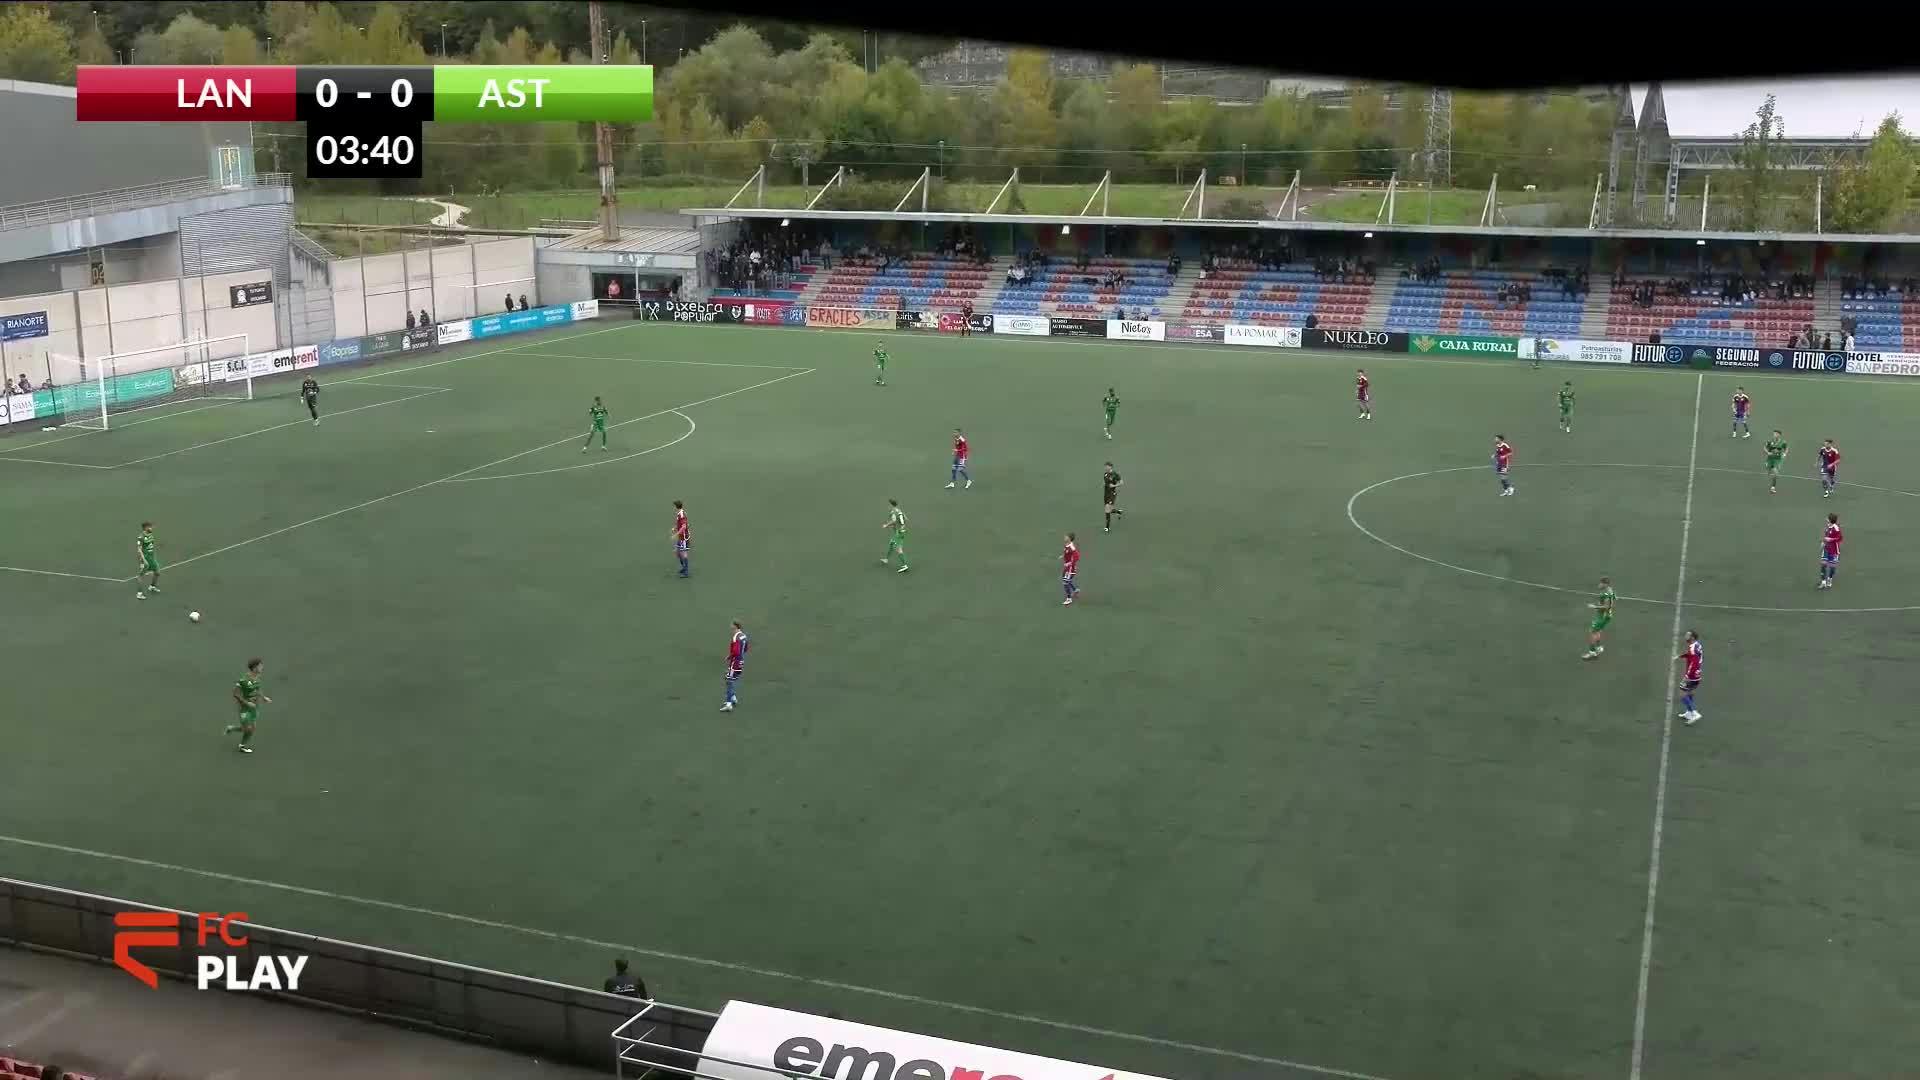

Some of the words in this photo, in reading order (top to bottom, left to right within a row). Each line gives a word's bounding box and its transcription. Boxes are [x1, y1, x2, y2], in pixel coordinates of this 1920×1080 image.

[7, 315, 45, 329] RIANORTE
[809, 308, 861, 326] GRACIES
[1121, 322, 1151, 334] Nieto's
[1244, 328, 1277, 338] POMAR
[1323, 331, 1388, 345] NUKLEO
[1439, 340, 1468, 351] CAJA
[1472, 342, 1515, 353] RURAL
[274, 350, 318, 368] emerent
[1716, 348, 1760, 362] SEGUNDA
[1848, 352, 1883, 362] HOTEL
